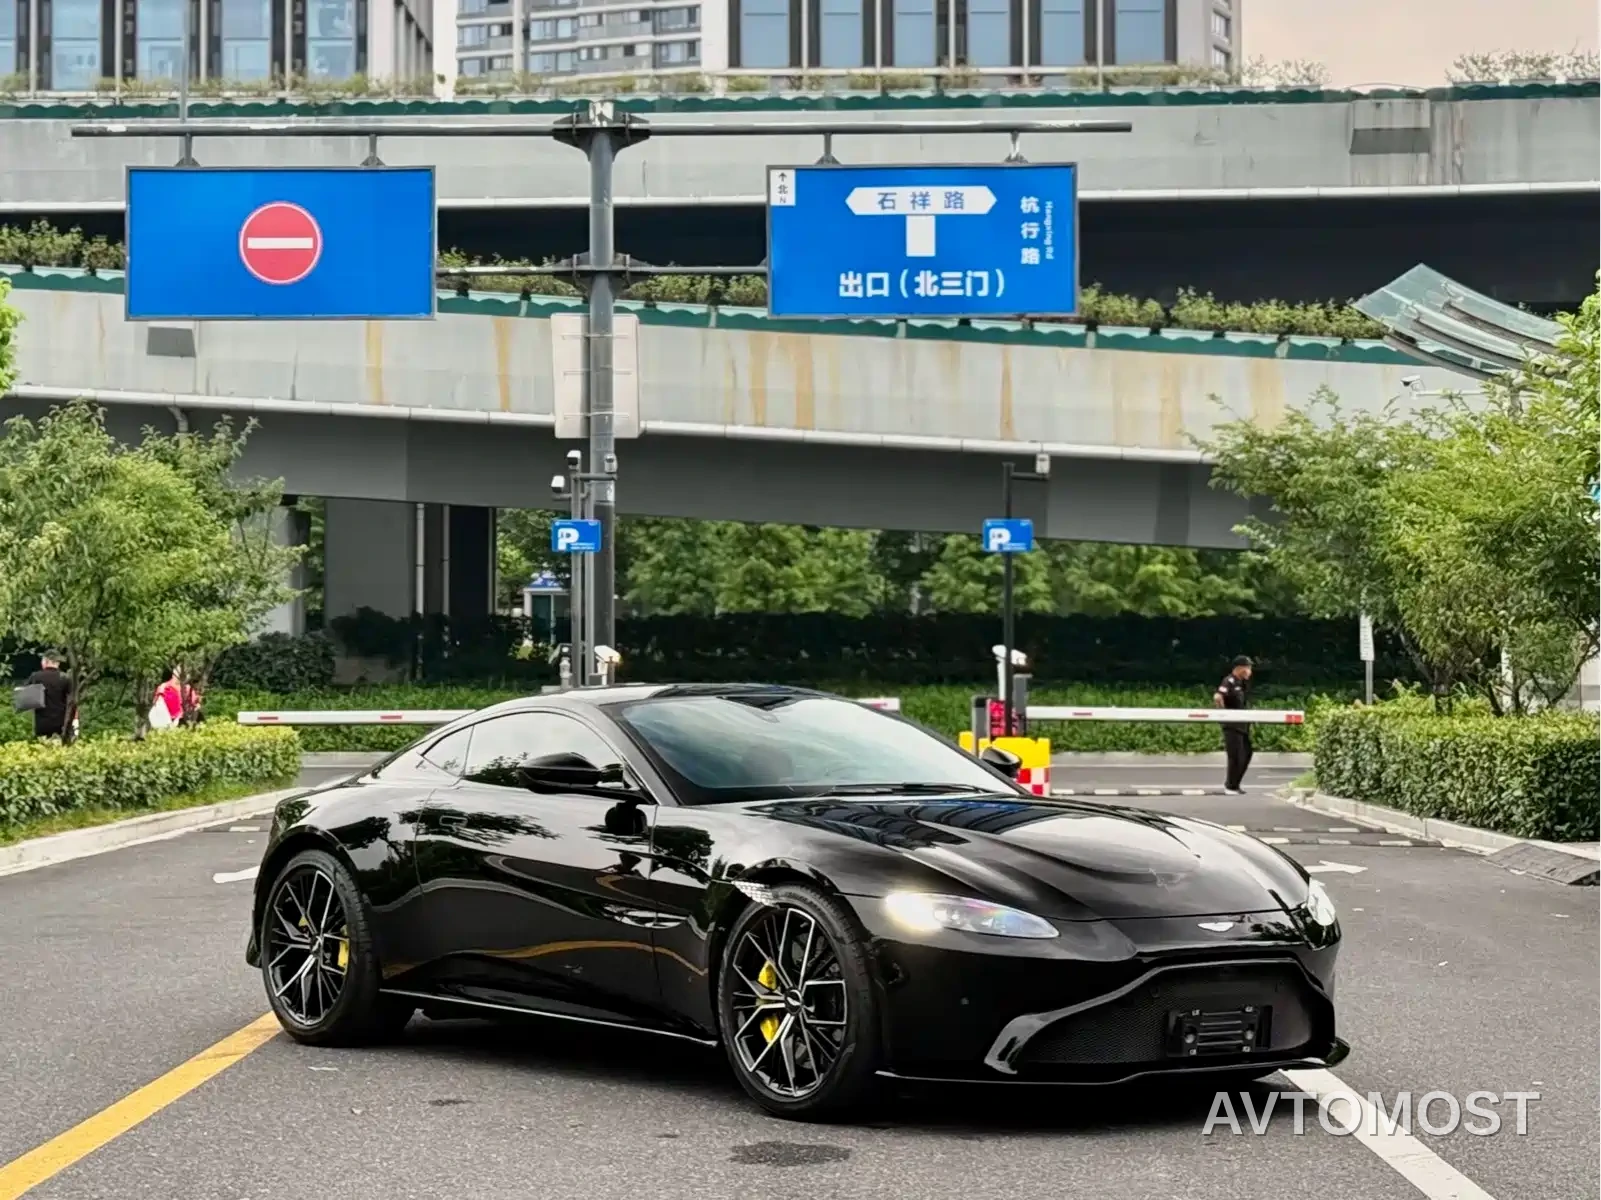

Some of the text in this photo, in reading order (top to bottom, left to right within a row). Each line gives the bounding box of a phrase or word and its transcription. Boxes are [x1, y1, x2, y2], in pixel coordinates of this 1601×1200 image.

[777, 183, 789, 195] 北
[877, 191, 965, 211] 石祥路
[1020, 196, 1040, 265] 杭行路
